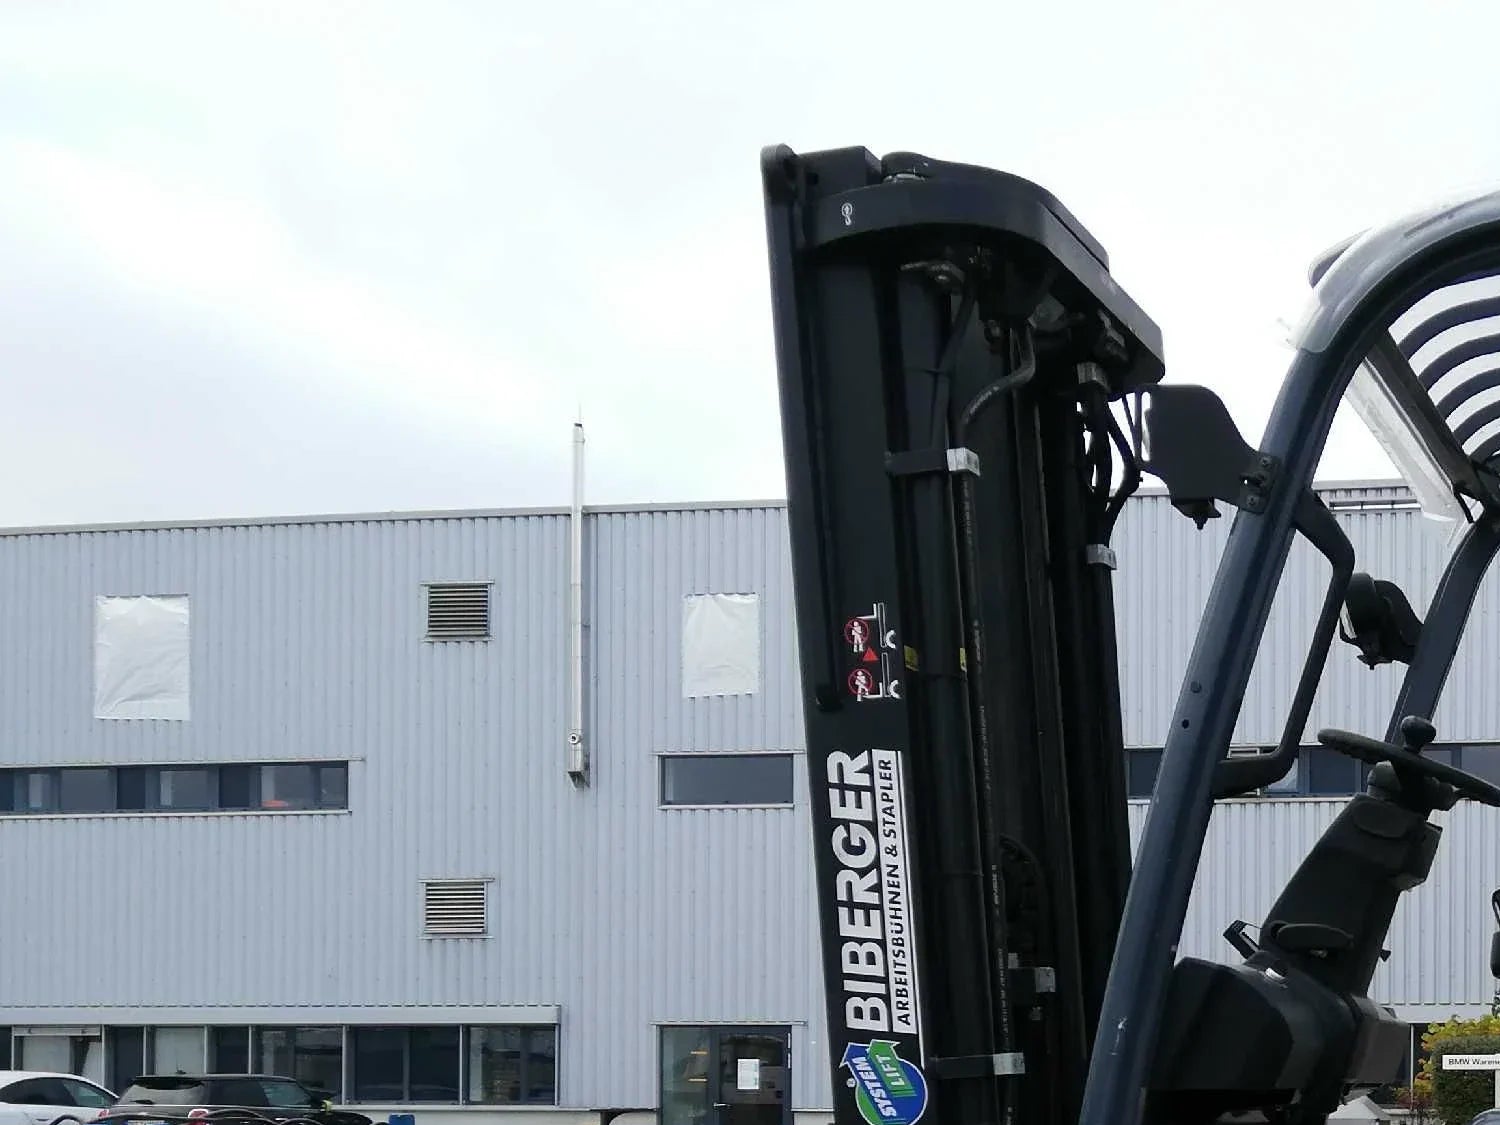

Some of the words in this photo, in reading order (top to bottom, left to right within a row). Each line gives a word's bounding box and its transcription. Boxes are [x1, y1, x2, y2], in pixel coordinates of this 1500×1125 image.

[878, 759, 897, 839] STAPLER
[884, 844, 898, 858] &
[827, 750, 889, 1032] BIBERGER
[885, 864, 911, 1026] ARBEITSBÜHNEN
[852, 1056, 898, 1117] SYSTEM
[875, 1054, 905, 1086] LIFT
[1448, 1057, 1470, 1066] BMW
